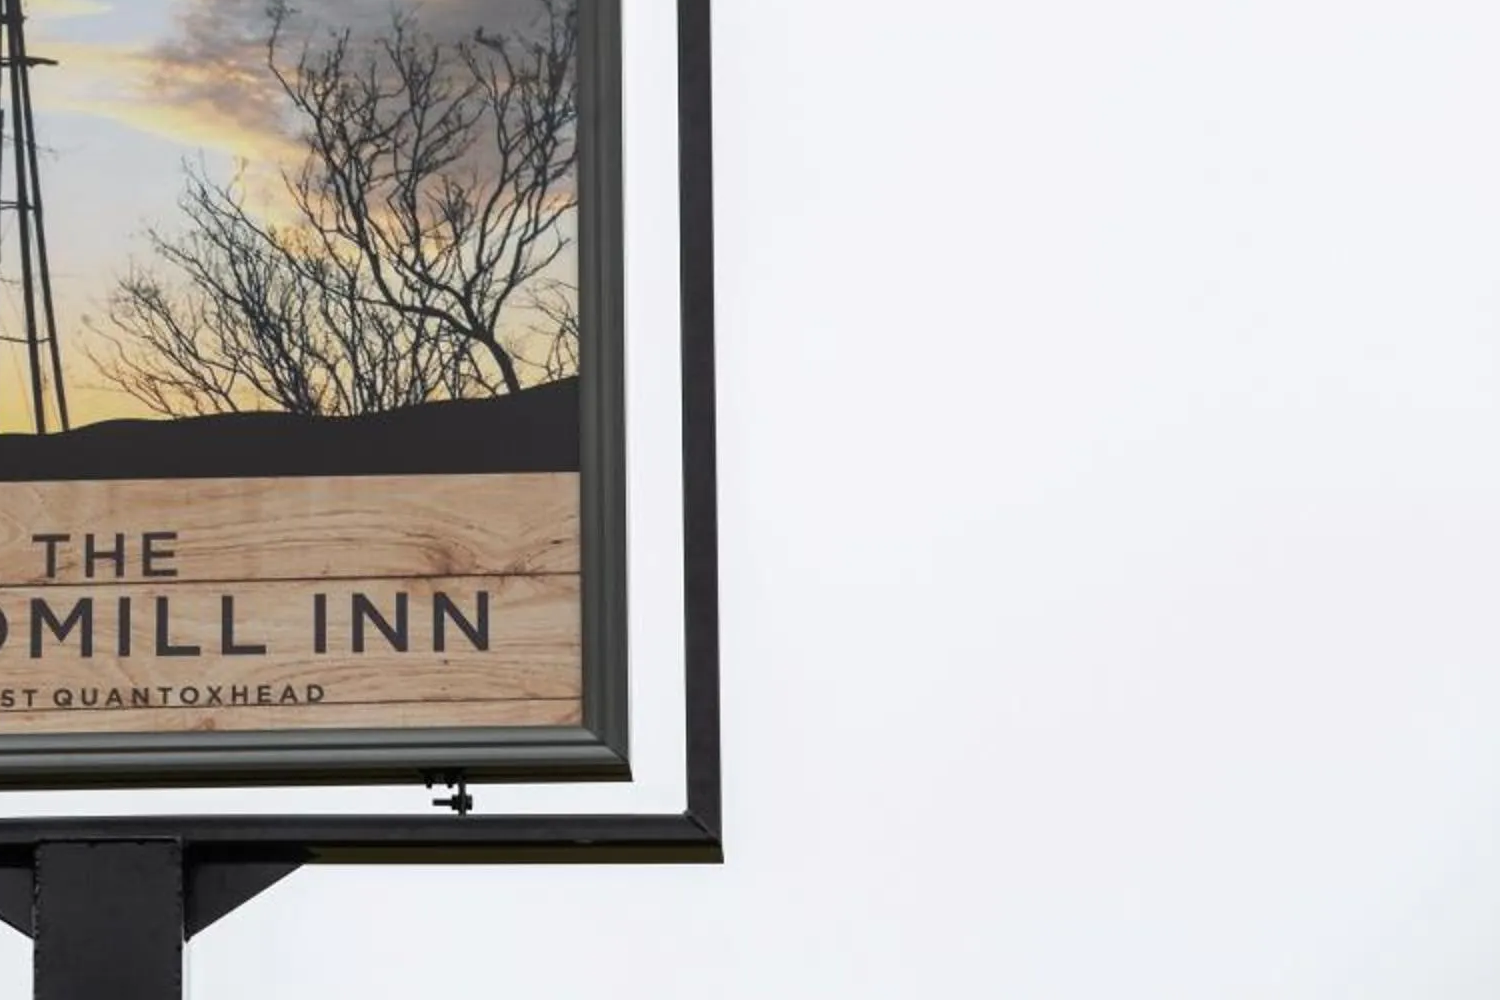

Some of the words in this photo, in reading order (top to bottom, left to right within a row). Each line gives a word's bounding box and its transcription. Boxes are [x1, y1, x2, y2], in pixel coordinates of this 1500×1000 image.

[31, 532, 179, 578] THE
[314, 590, 491, 654] INN
[52, 683, 326, 708] QUANTOXHEAD
